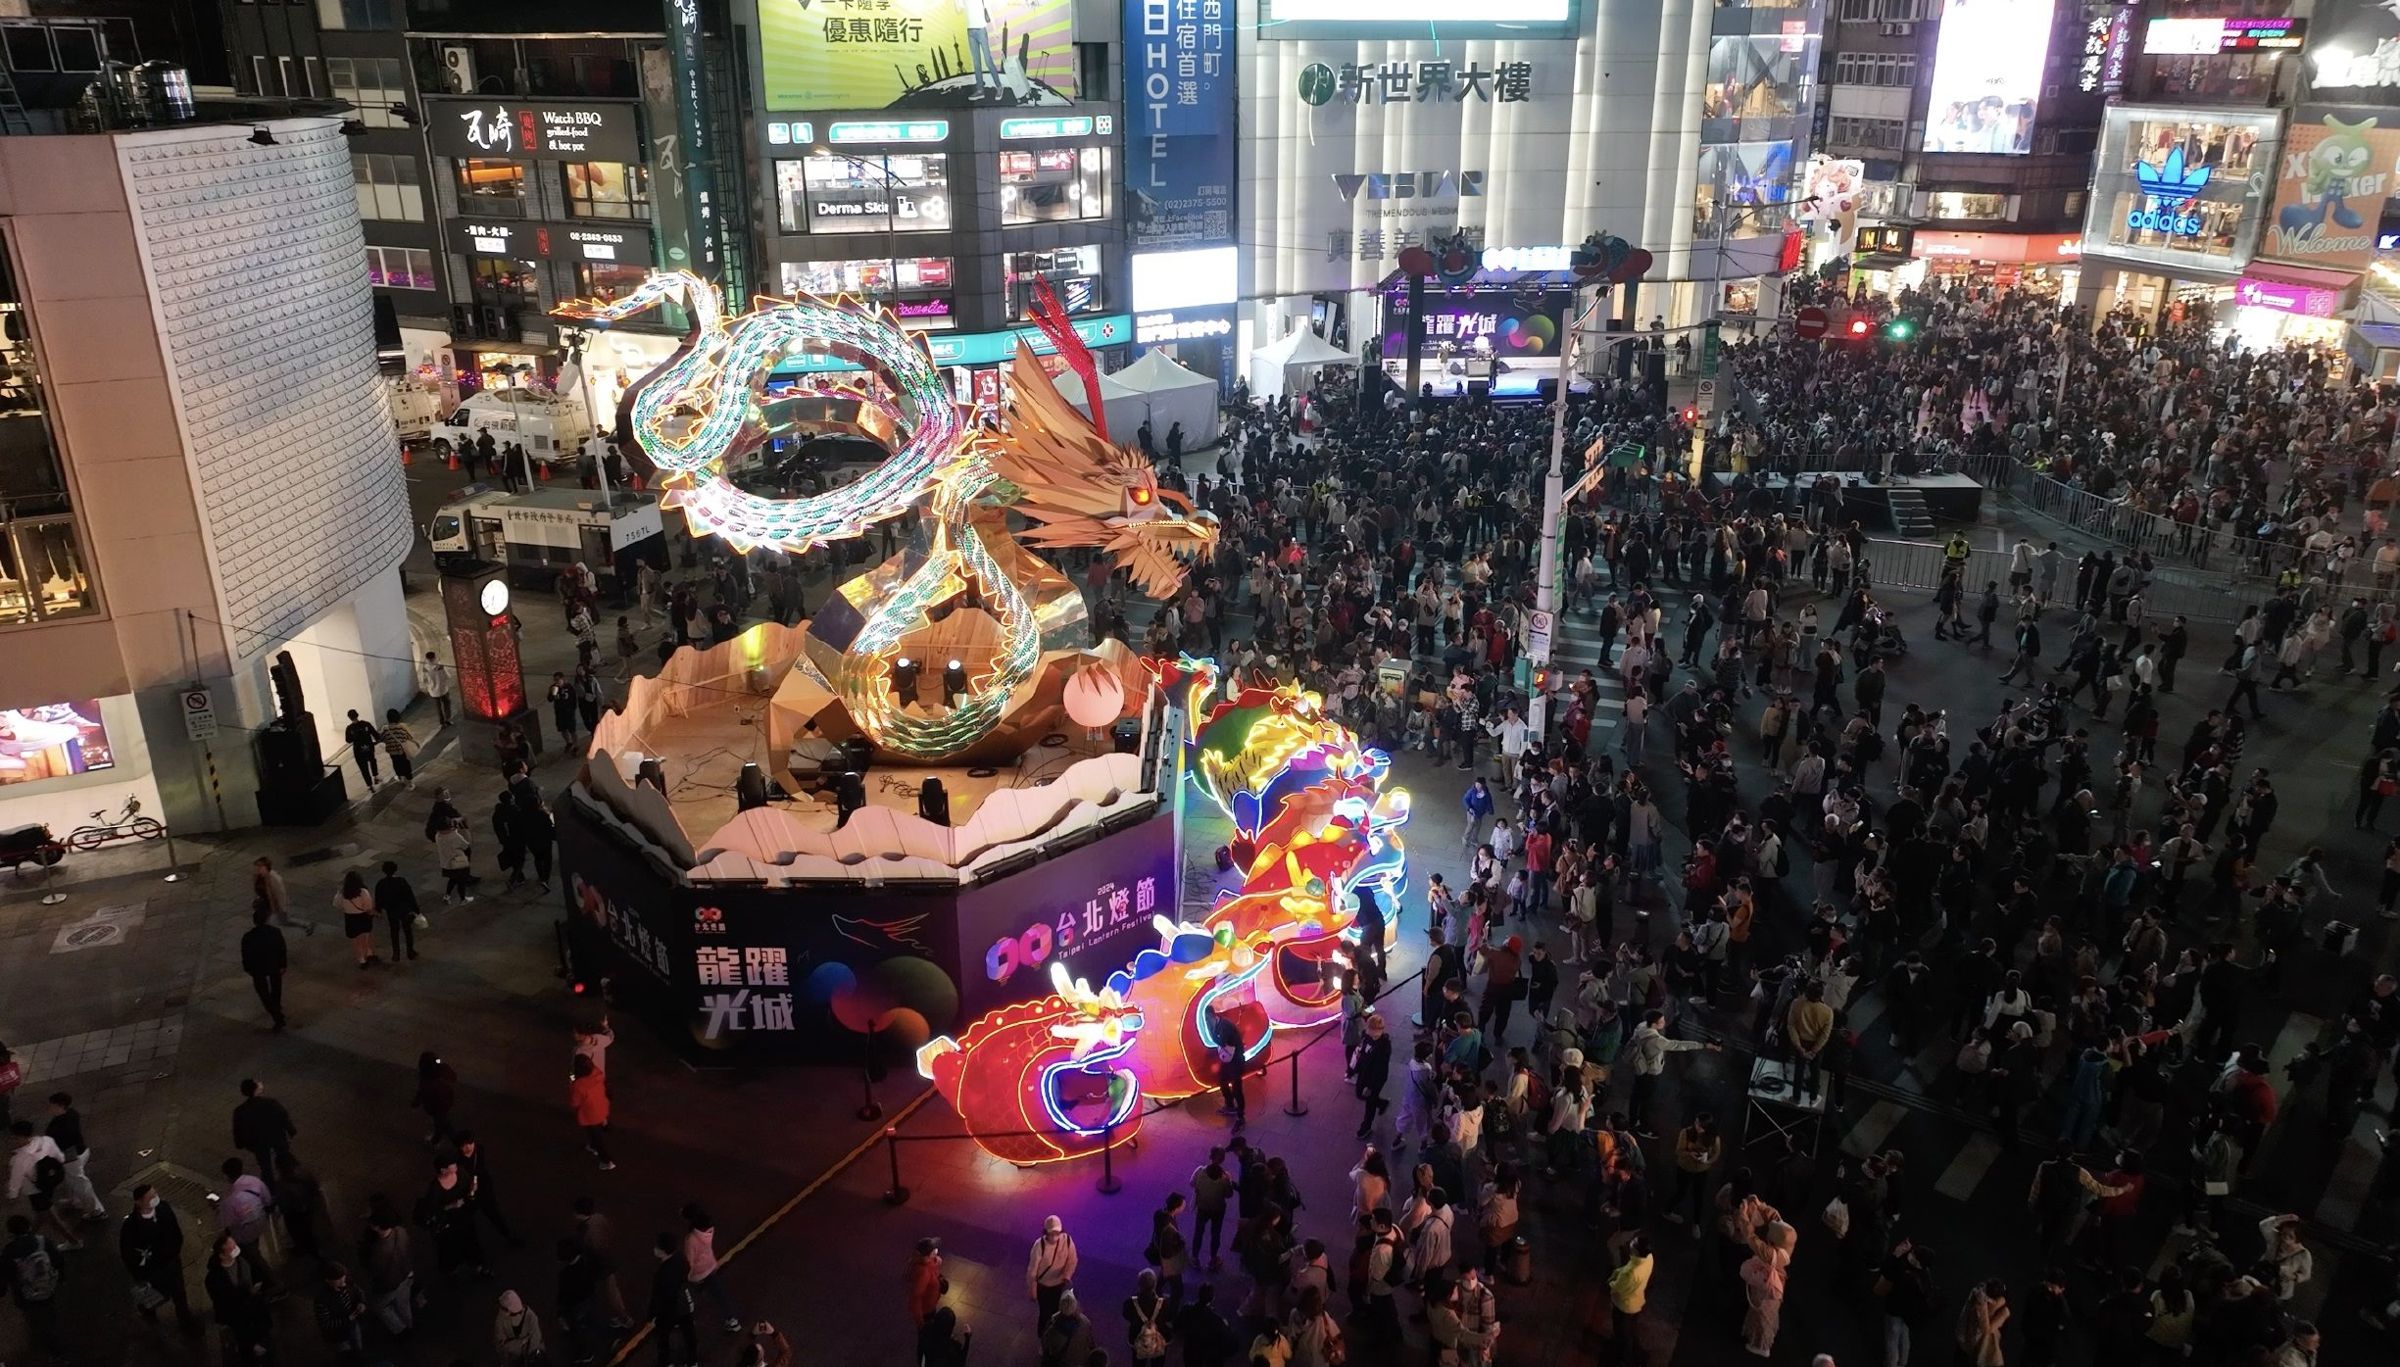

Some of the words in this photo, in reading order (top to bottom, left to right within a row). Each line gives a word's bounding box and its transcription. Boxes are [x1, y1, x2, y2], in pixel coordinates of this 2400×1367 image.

[822, 17, 923, 43] 優惠隨行
[1338, 61, 1532, 105] 新世界大樓
[543, 111, 574, 124] Watch
[576, 111, 602, 126] BBQ
[1147, 43, 1169, 187] HOTEL
[1332, 171, 1483, 201] WESTAR
[817, 202, 863, 216] Derma
[2127, 209, 2200, 235] adidas
[2268, 222, 2372, 256] Welcome
[1097, 882, 1115, 896] 2024
[1056, 876, 1156, 947] 台北燈節
[1058, 941, 1085, 961] Taipei
[1088, 927, 1120, 947] Lantern
[695, 946, 790, 986] 龍躍
[698, 988, 796, 1040] 光城
